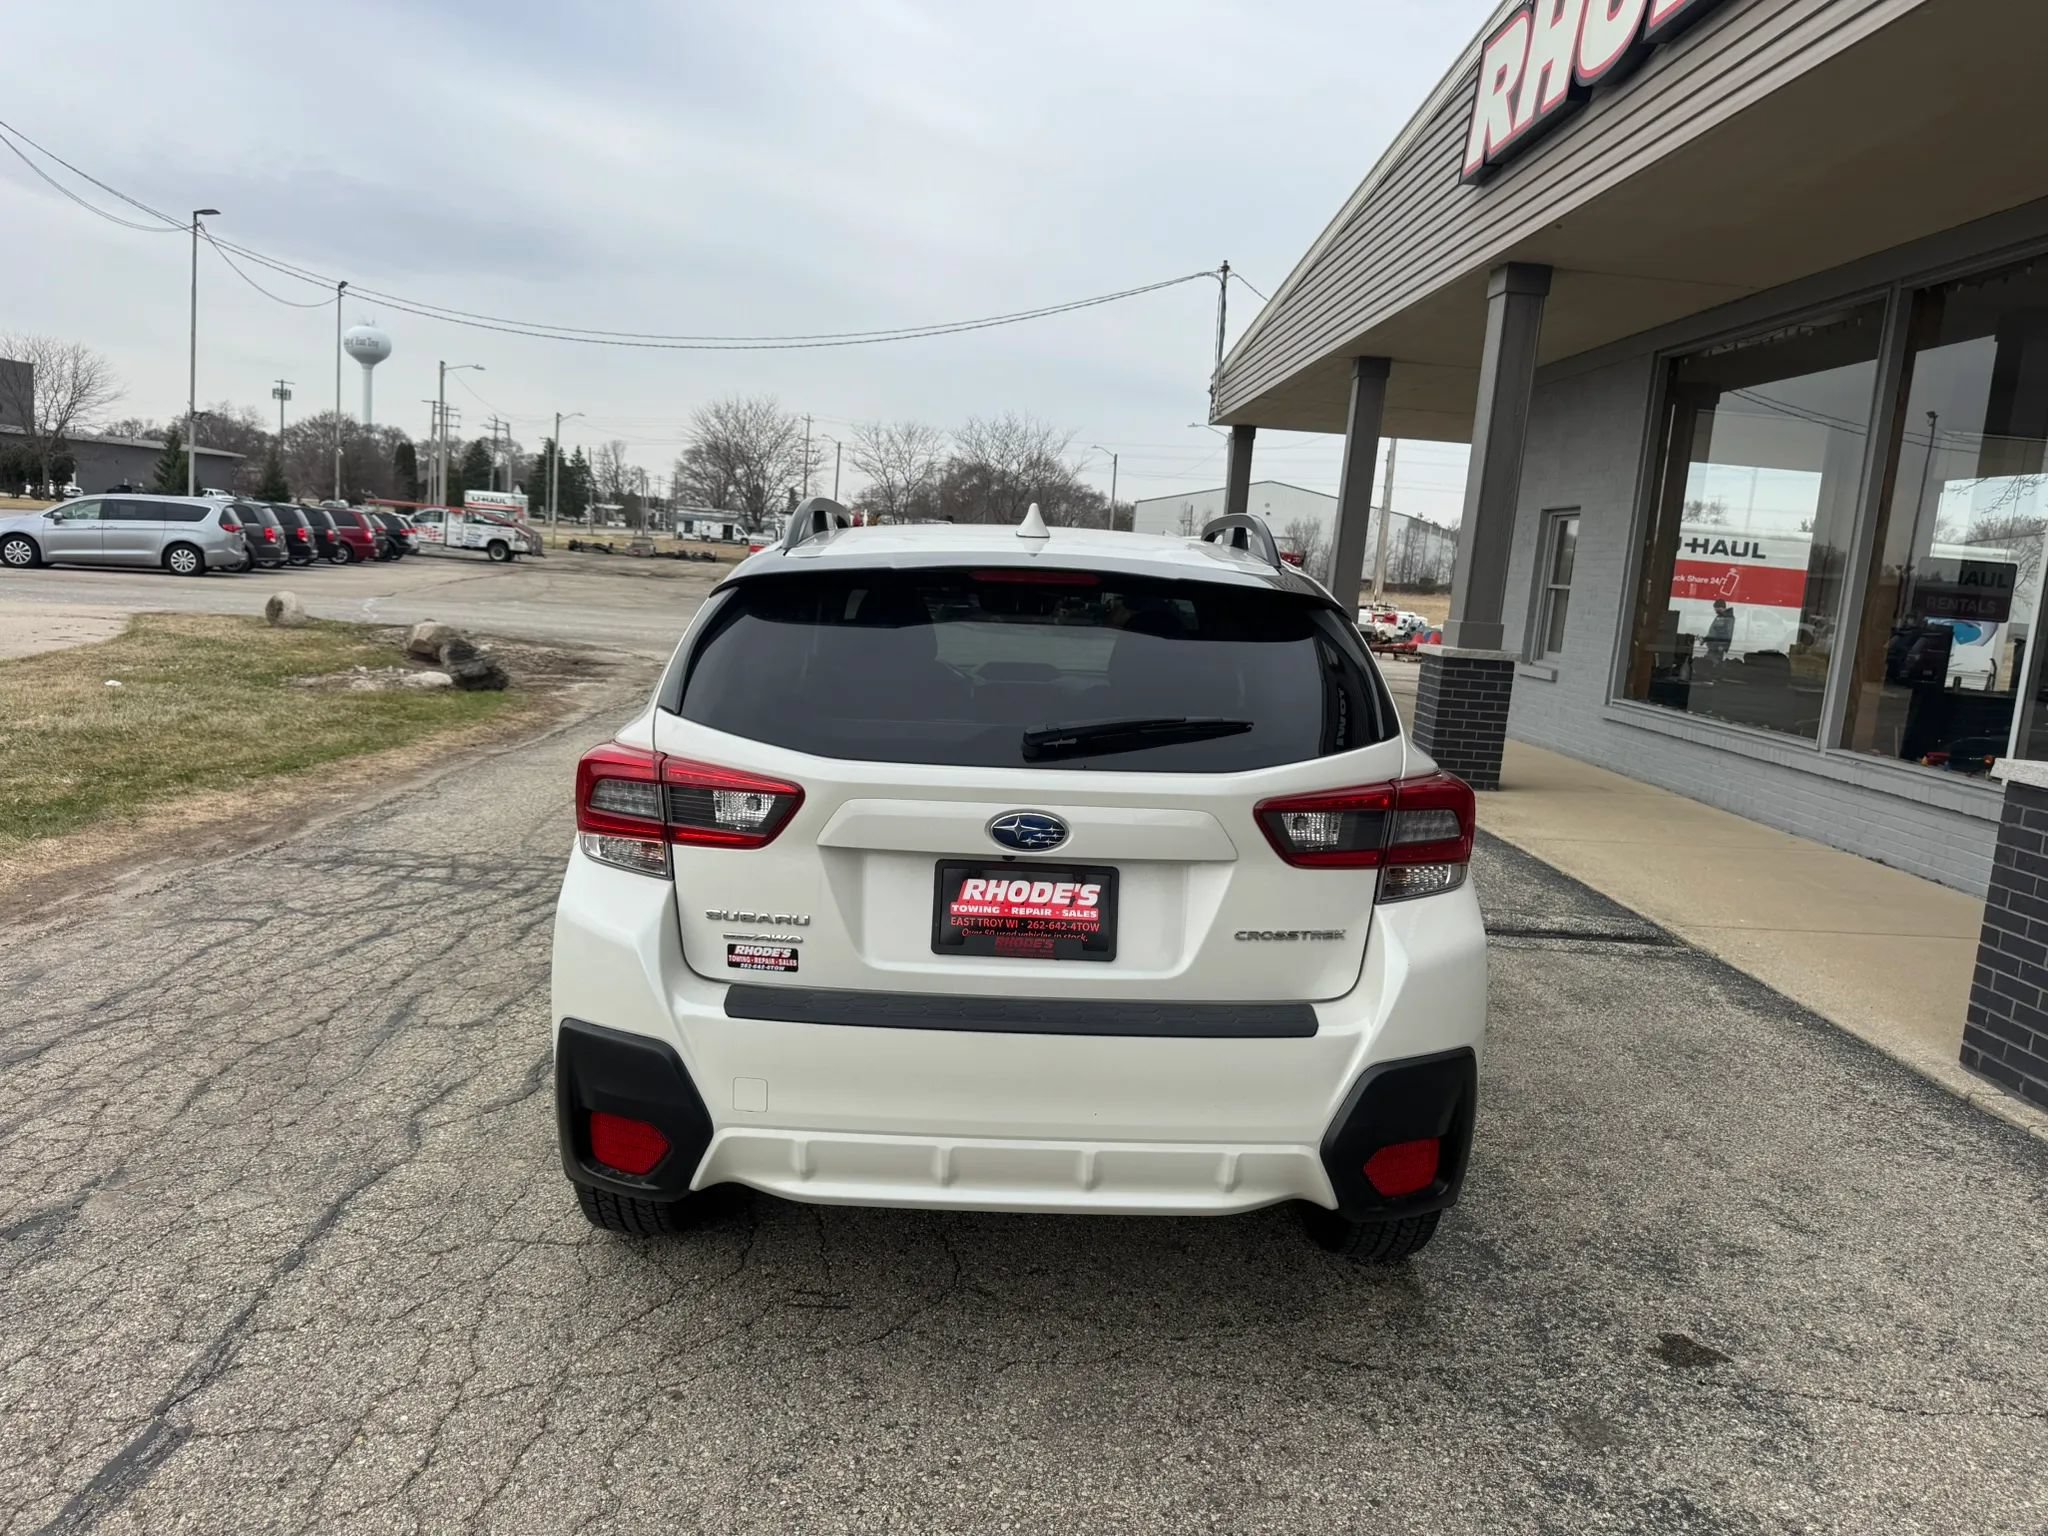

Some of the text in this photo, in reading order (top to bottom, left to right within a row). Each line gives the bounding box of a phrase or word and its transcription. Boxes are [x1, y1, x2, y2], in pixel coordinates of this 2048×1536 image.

[1459, 0, 1692, 182] RHO
[1679, 536, 1767, 560] -HAUL
[1687, 574, 1709, 584] Share
[1958, 568, 2009, 589] AUL
[1927, 594, 1998, 615] RENTALS
[959, 878, 1102, 907] RHODE'S
[705, 909, 811, 927] SUBARU
[951, 904, 1097, 918] TOWING REPAIR SALES
[950, 917, 1100, 932] EAST TROY WI 262-642-4TOW
[995, 937, 1056, 949] RHODE'S
[1233, 929, 1347, 942] CROSSTREK
[734, 945, 792, 958] RHODE'S
